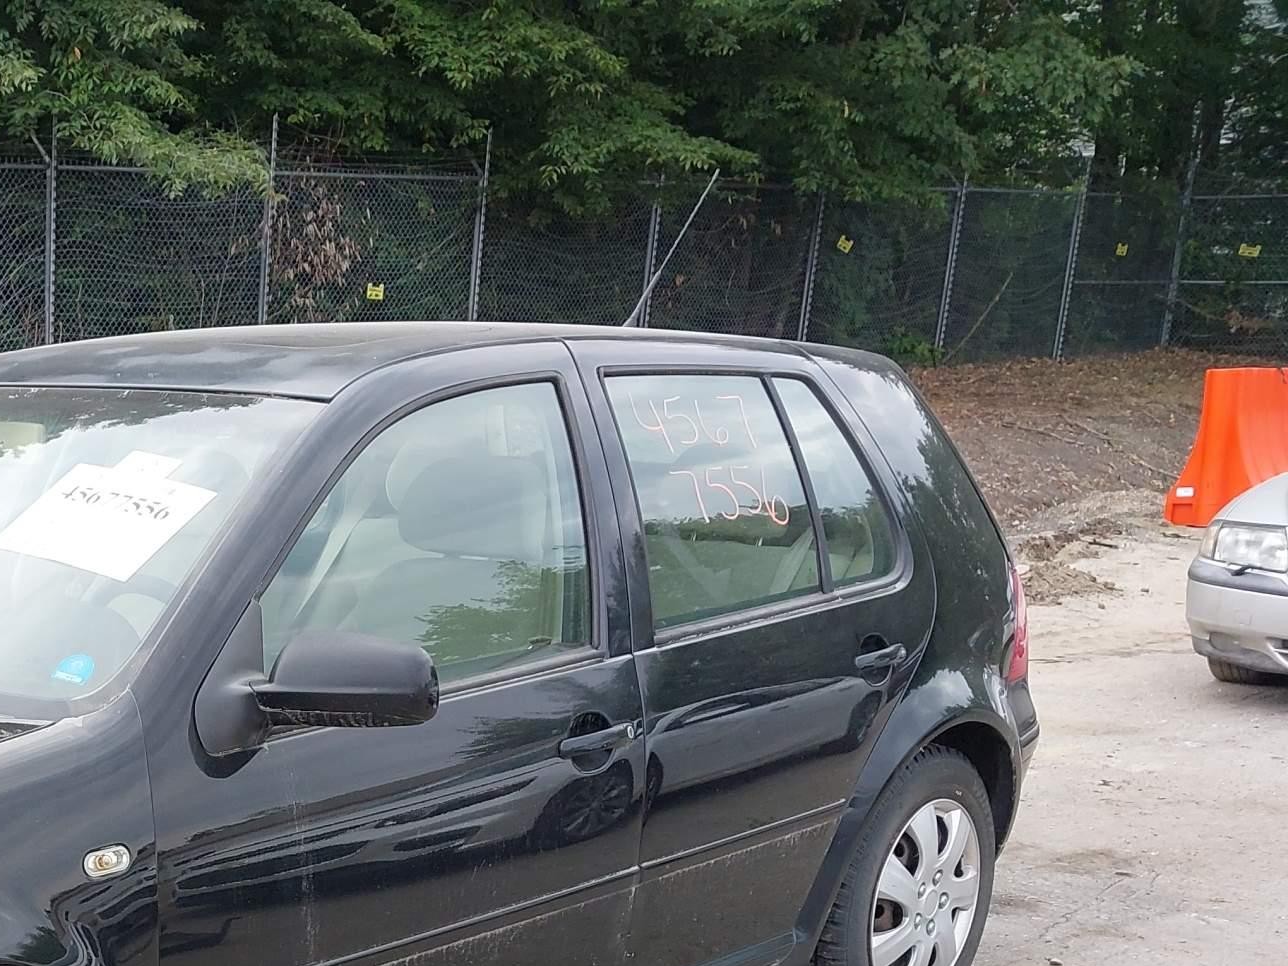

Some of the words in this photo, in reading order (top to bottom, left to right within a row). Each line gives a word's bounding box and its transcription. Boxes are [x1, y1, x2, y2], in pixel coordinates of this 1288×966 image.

[628, 392, 757, 453] 4567
[62, 486, 171, 521] 45677556
[668, 465, 790, 526] 7556
